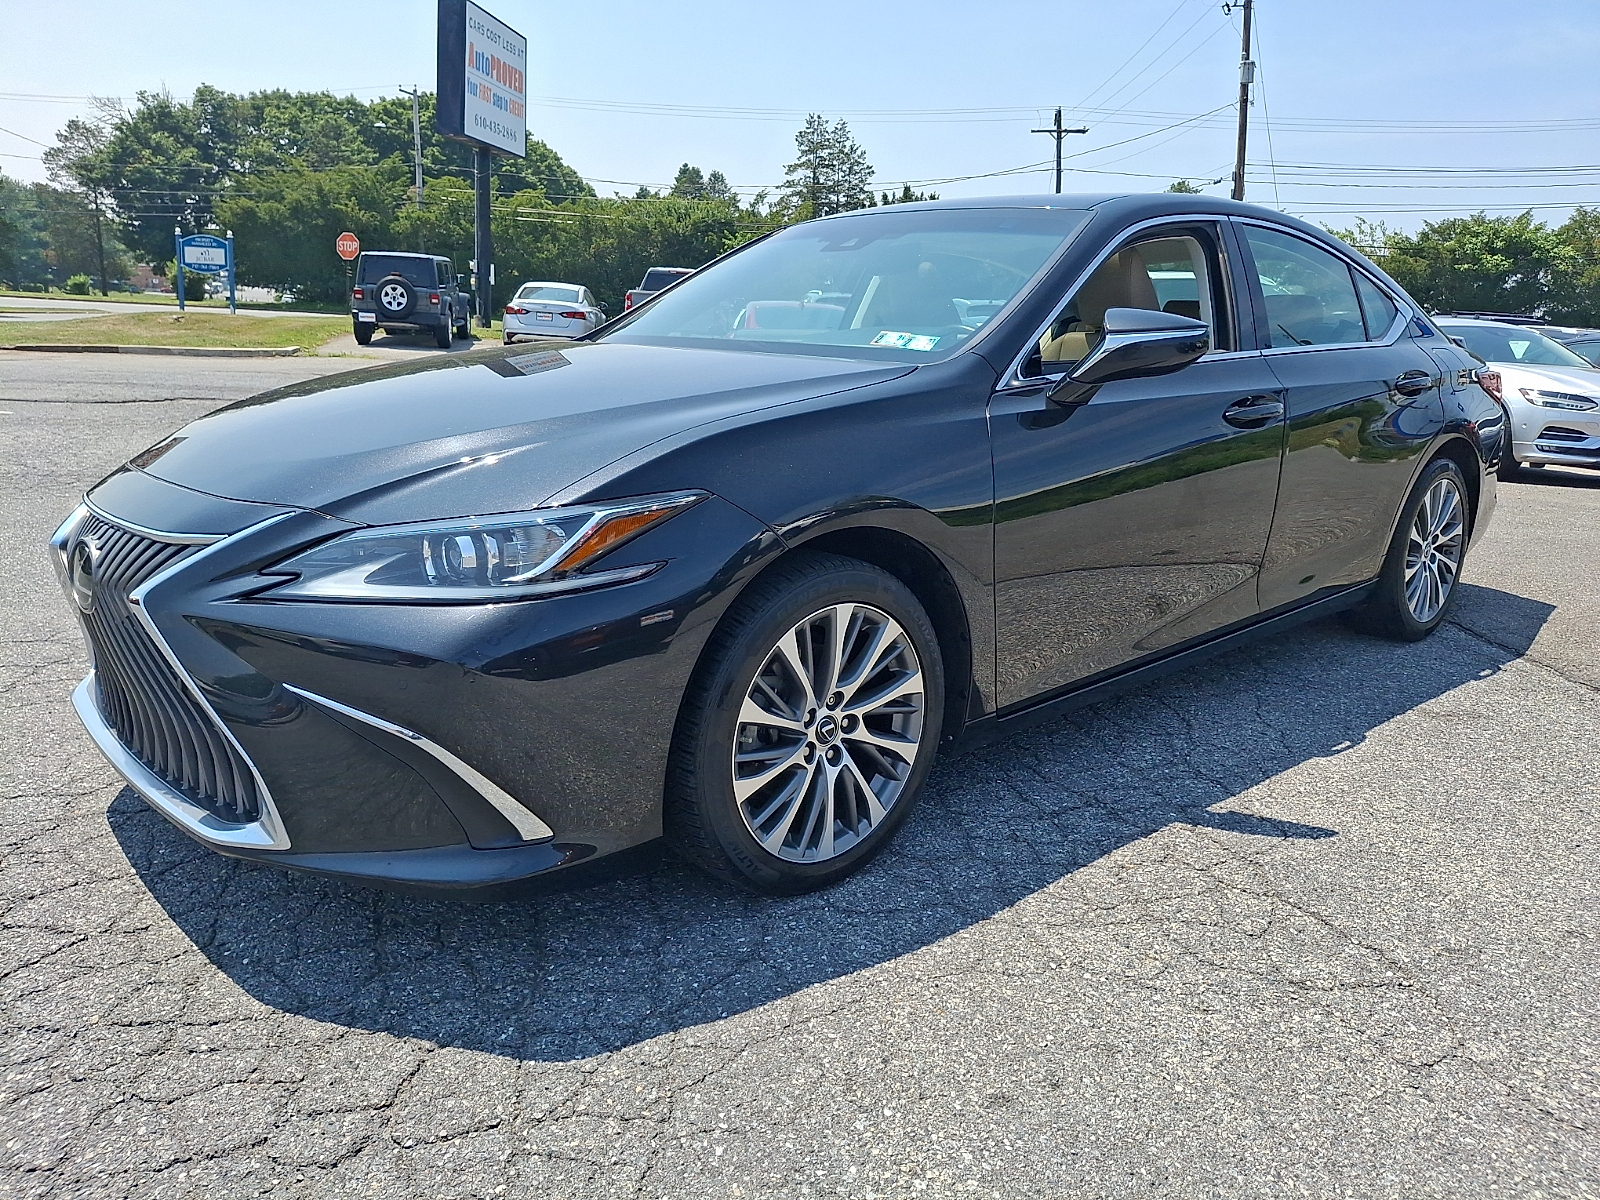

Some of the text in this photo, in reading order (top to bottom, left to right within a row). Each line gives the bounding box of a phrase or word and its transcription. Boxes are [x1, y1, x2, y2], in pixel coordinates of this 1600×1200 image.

[469, 17, 524, 60] CARS COST LESS AT
[468, 41, 524, 94] AutoPROVED
[467, 76, 478, 97] Your
[479, 82, 492, 104] FIRST
[493, 92, 503, 111] step
[509, 98, 524, 119] CREDIT
[338, 240, 358, 252] STOP
[776, 579, 850, 620] GENERAL
